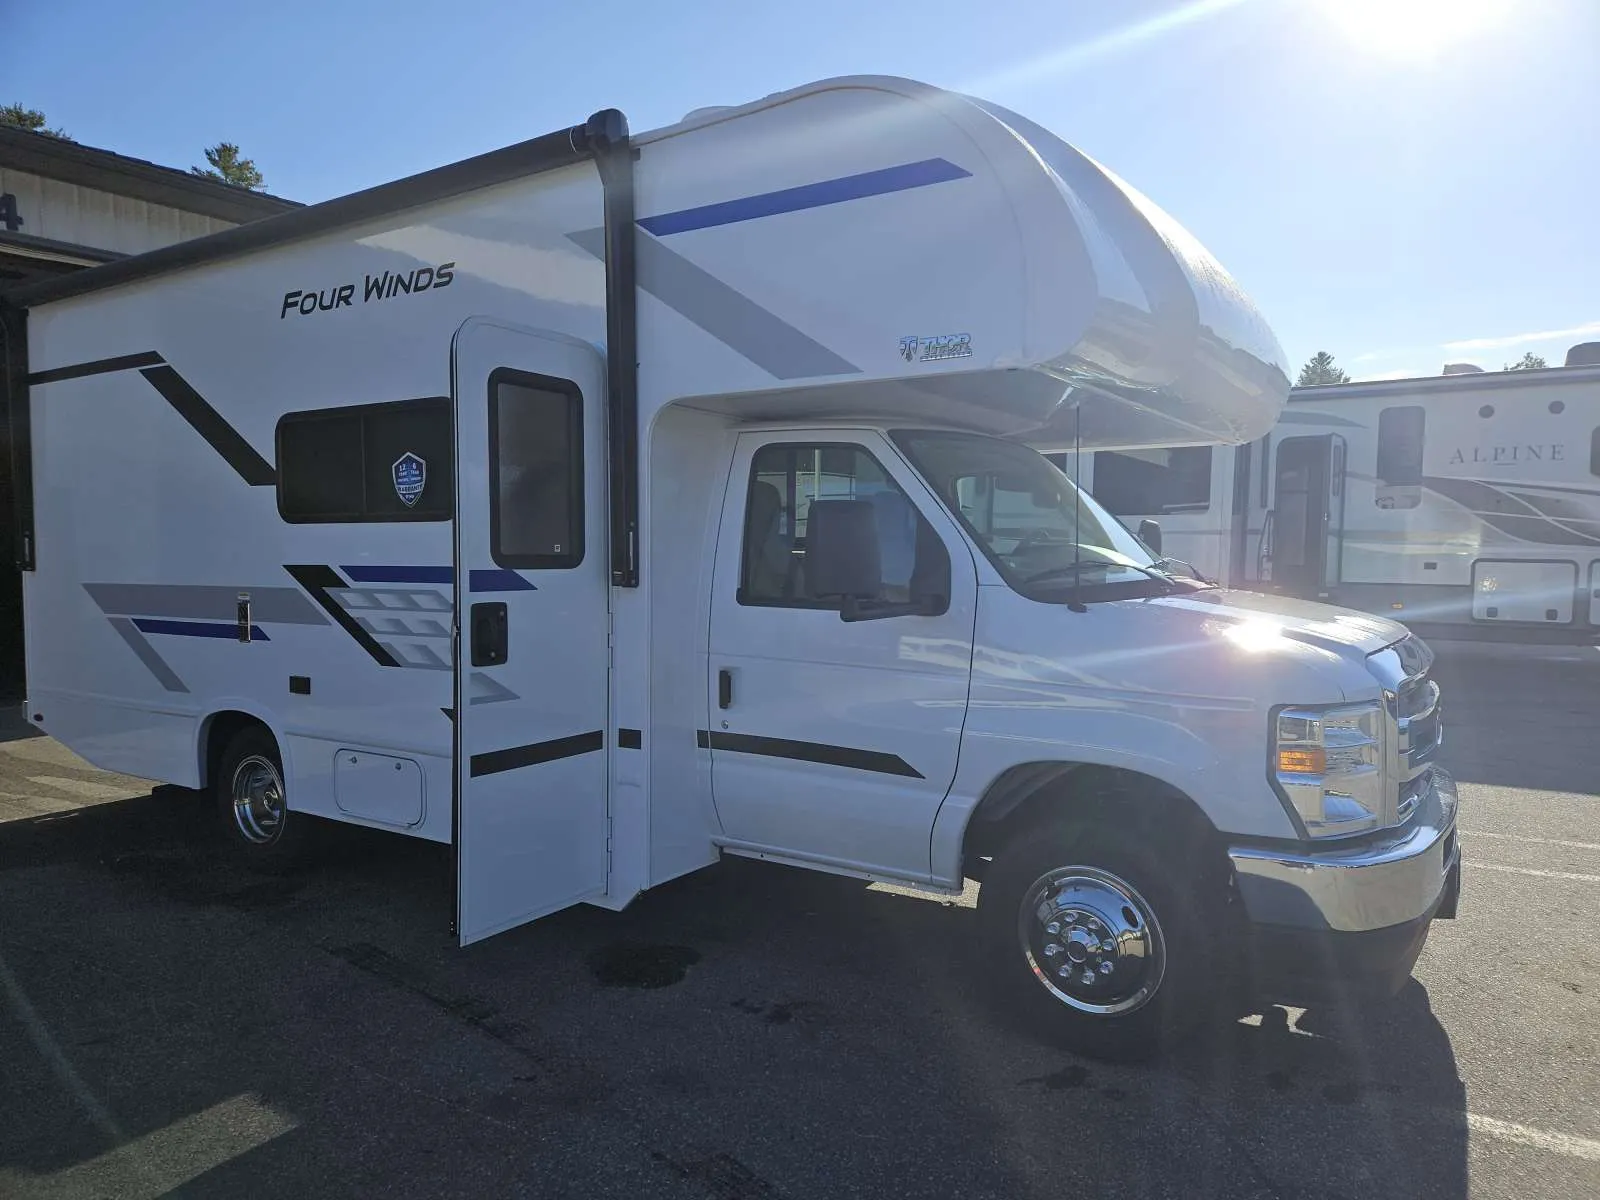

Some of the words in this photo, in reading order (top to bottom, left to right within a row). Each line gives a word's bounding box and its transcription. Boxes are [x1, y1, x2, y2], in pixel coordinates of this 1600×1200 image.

[280, 284, 355, 319] FOUR
[364, 262, 456, 302] WINDS
[1449, 444, 1564, 464] ALPINE
